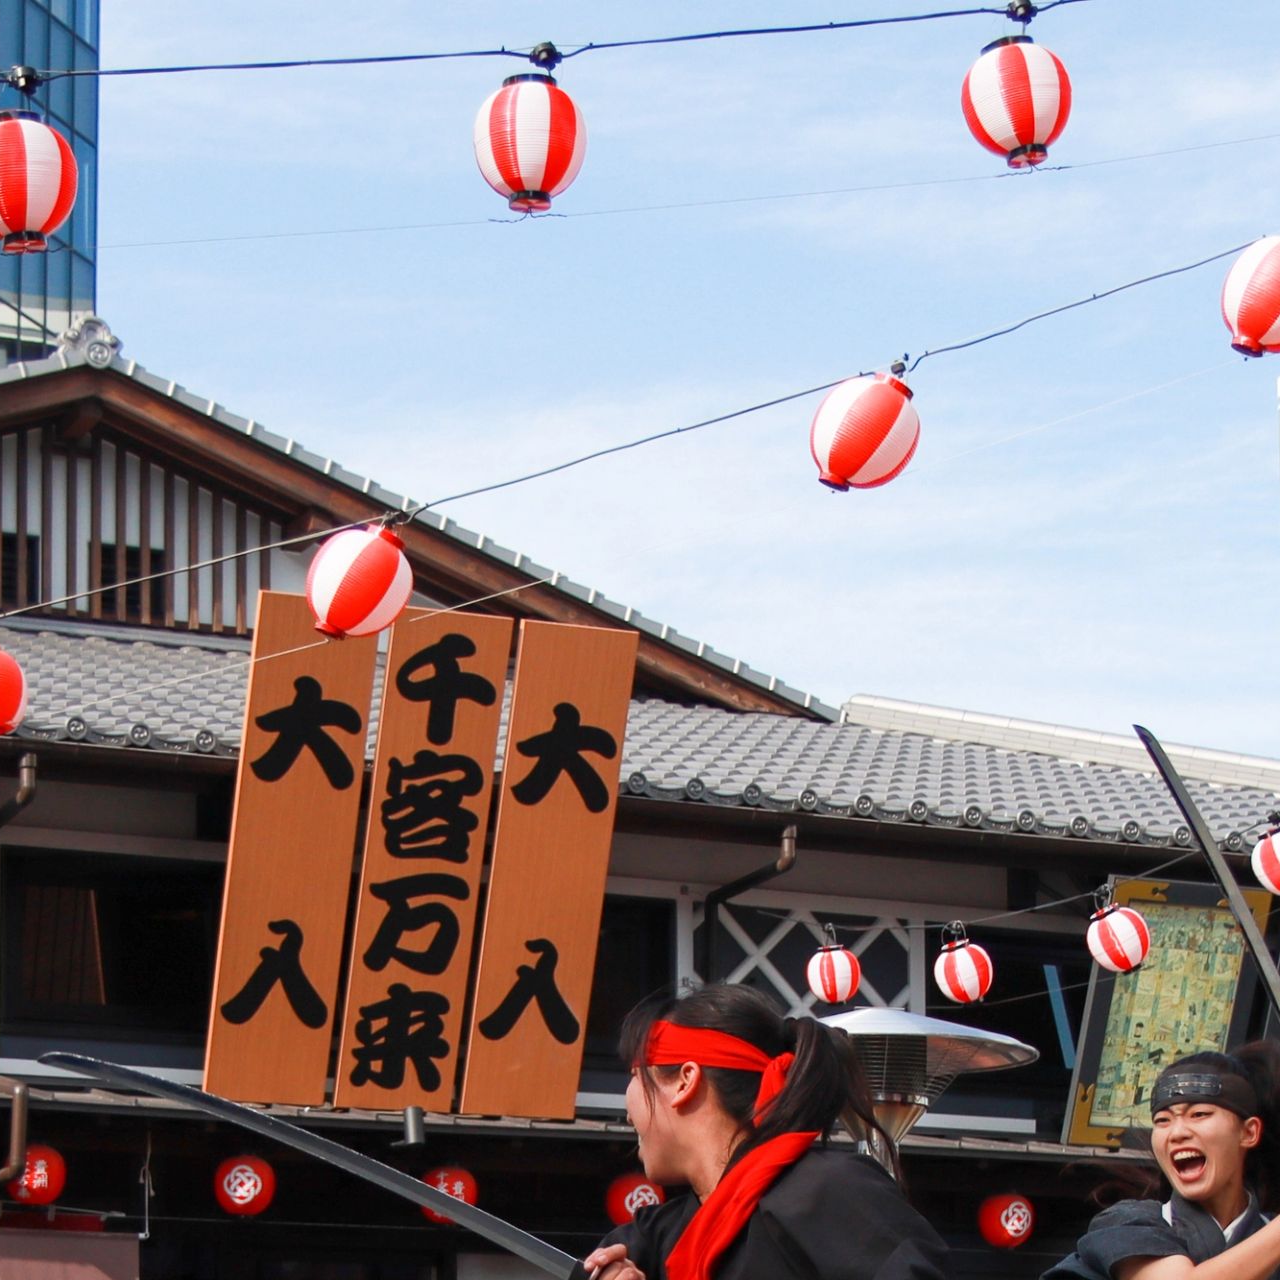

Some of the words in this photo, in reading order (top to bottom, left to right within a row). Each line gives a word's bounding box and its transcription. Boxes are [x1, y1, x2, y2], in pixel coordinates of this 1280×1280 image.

[220, 674, 363, 1030] 大入
[349, 632, 497, 1093] 千客万来
[478, 701, 617, 1045] 大入
